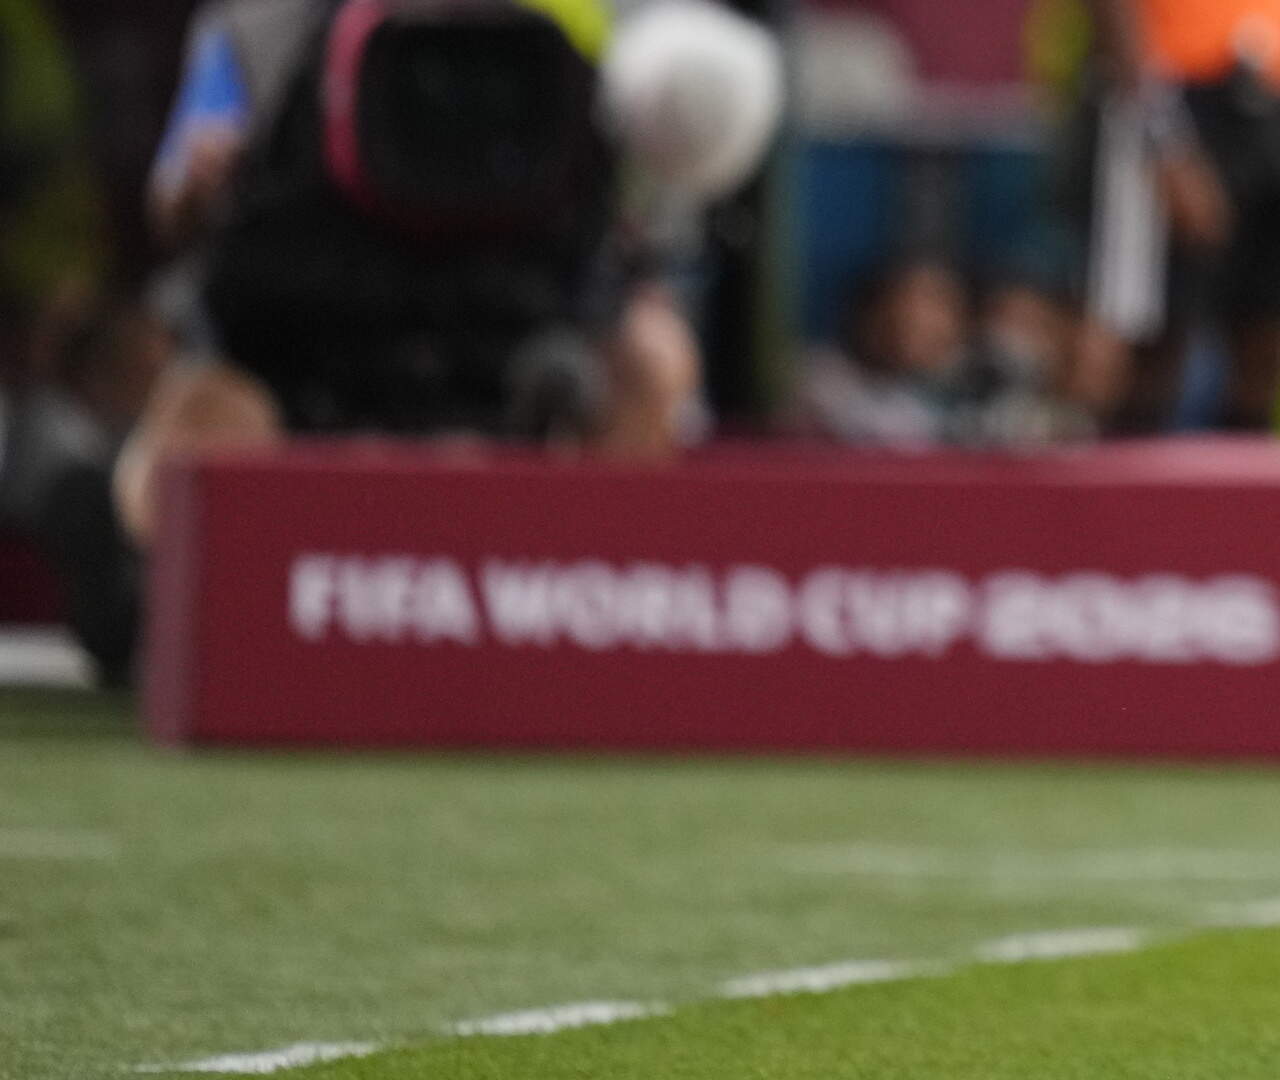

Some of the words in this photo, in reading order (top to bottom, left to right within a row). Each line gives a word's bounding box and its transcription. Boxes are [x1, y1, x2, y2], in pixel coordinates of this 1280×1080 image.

[290, 555, 480, 646] FIFA
[481, 558, 794, 655] WORLD
[799, 565, 972, 661] CUP
